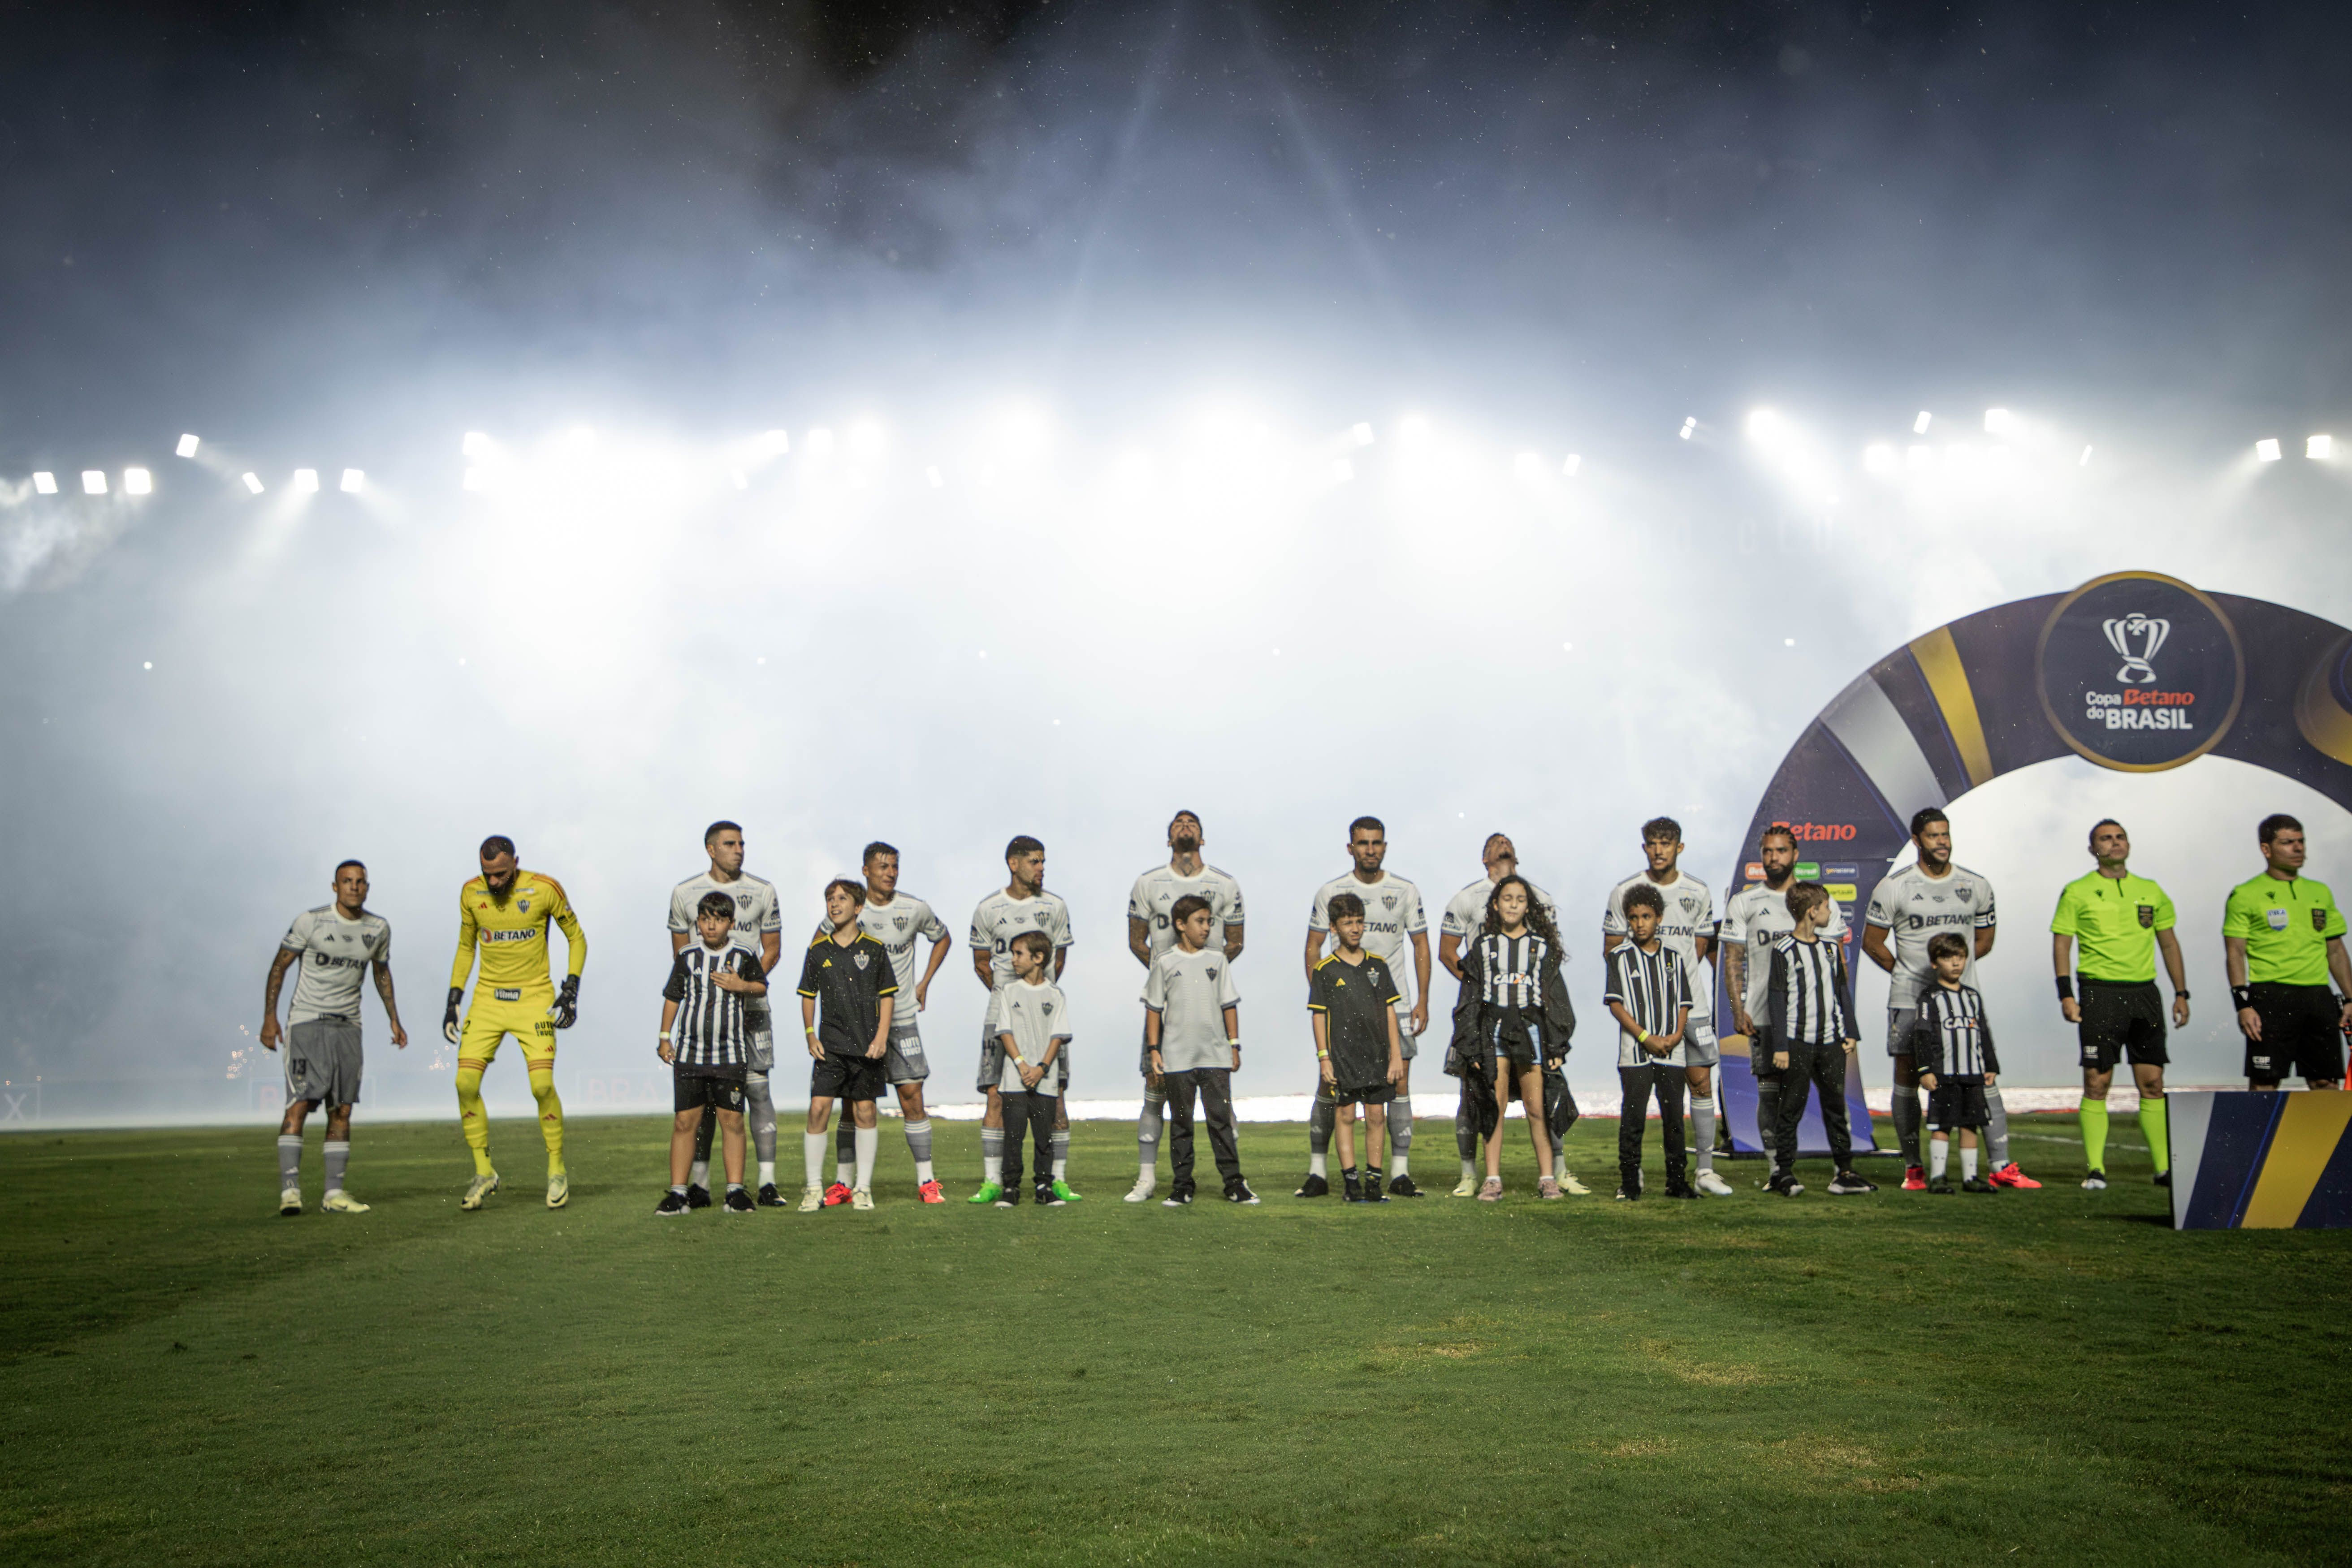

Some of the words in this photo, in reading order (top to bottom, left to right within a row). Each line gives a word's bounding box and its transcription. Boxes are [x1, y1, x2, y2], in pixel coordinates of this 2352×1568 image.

[2086, 691, 2121, 708] Copa
[2123, 689, 2195, 706] Betano
[2086, 706, 2105, 720] do
[2105, 708, 2193, 730] BRASIL
[494, 928, 536, 941] BETANO
[331, 956, 367, 970] BETAN
[1493, 972, 1533, 986] CAIXA
